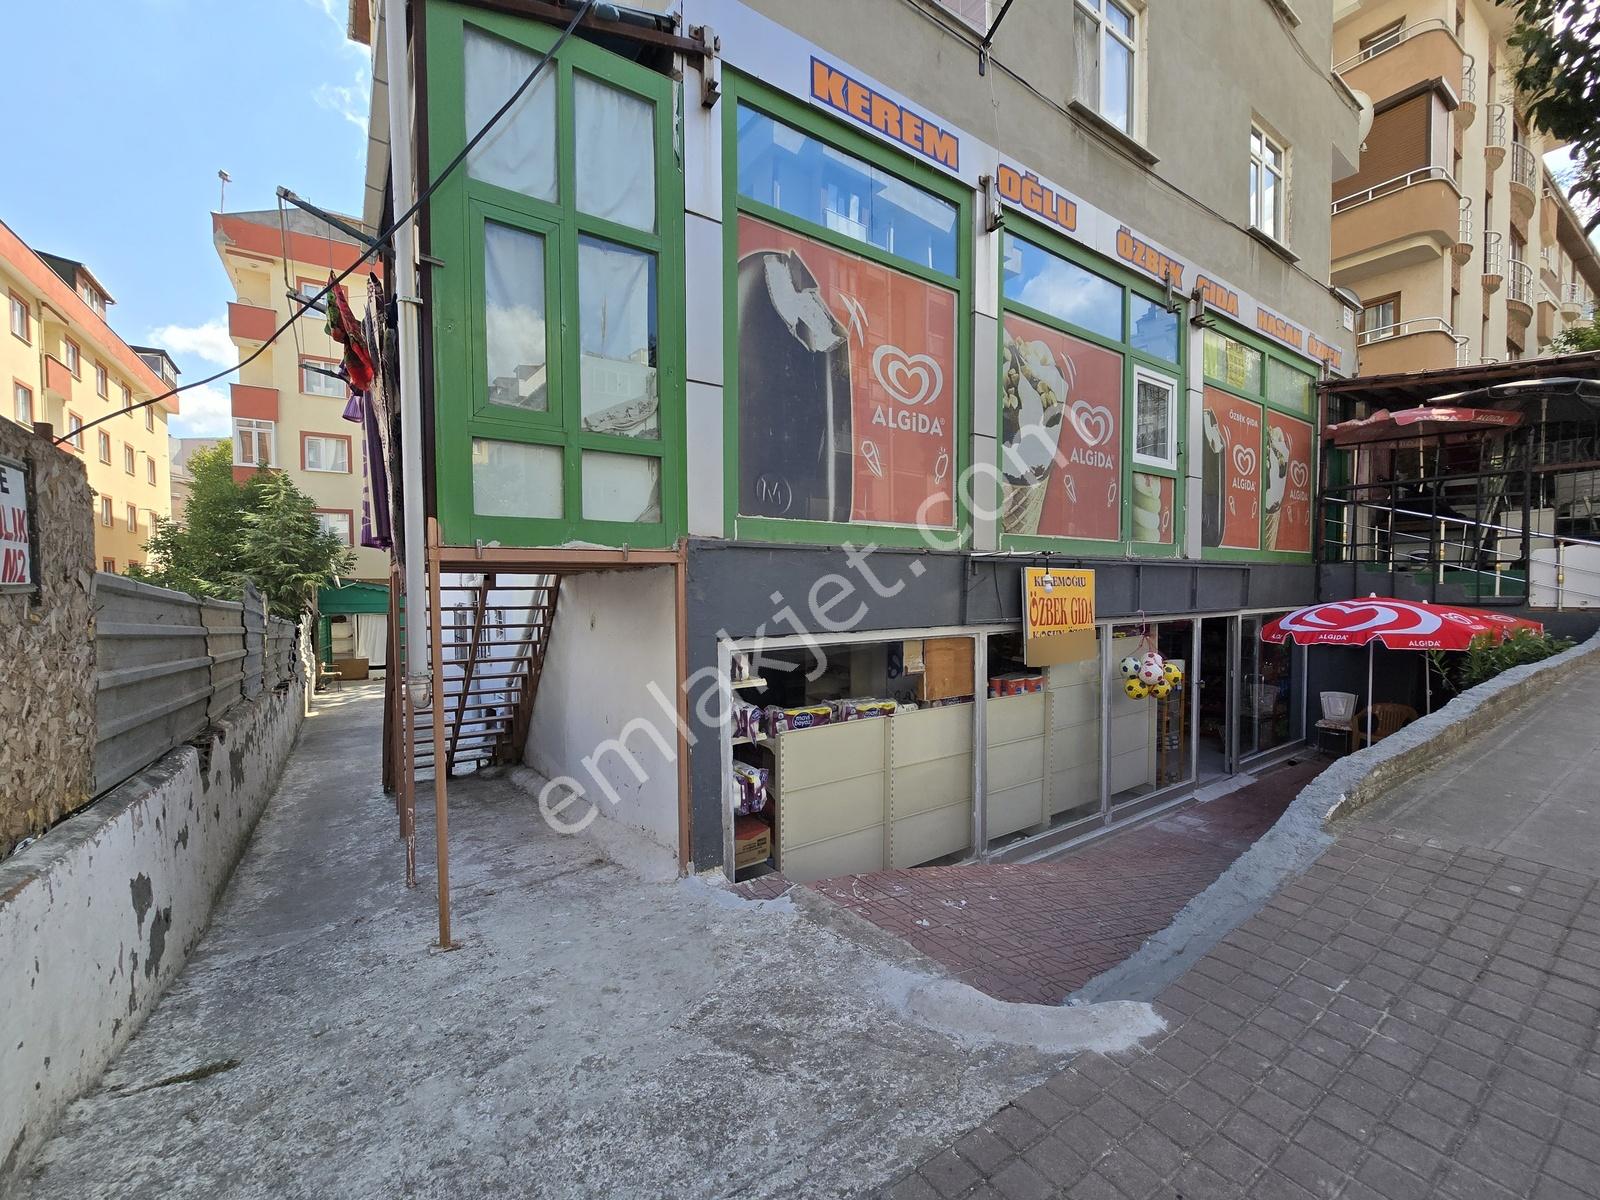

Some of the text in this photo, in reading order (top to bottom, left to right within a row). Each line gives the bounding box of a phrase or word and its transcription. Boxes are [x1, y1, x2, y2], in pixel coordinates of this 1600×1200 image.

[810, 54, 960, 173] KEREM
[997, 163, 1078, 233] OĞLU
[1115, 224, 1185, 291] ÖZBEK
[0, 504, 28, 543] LIK
[2, 548, 26, 583] M2
[1030, 591, 1094, 627] ÖZBEK GIDA
[1408, 640, 1441, 648] ALGIDA
